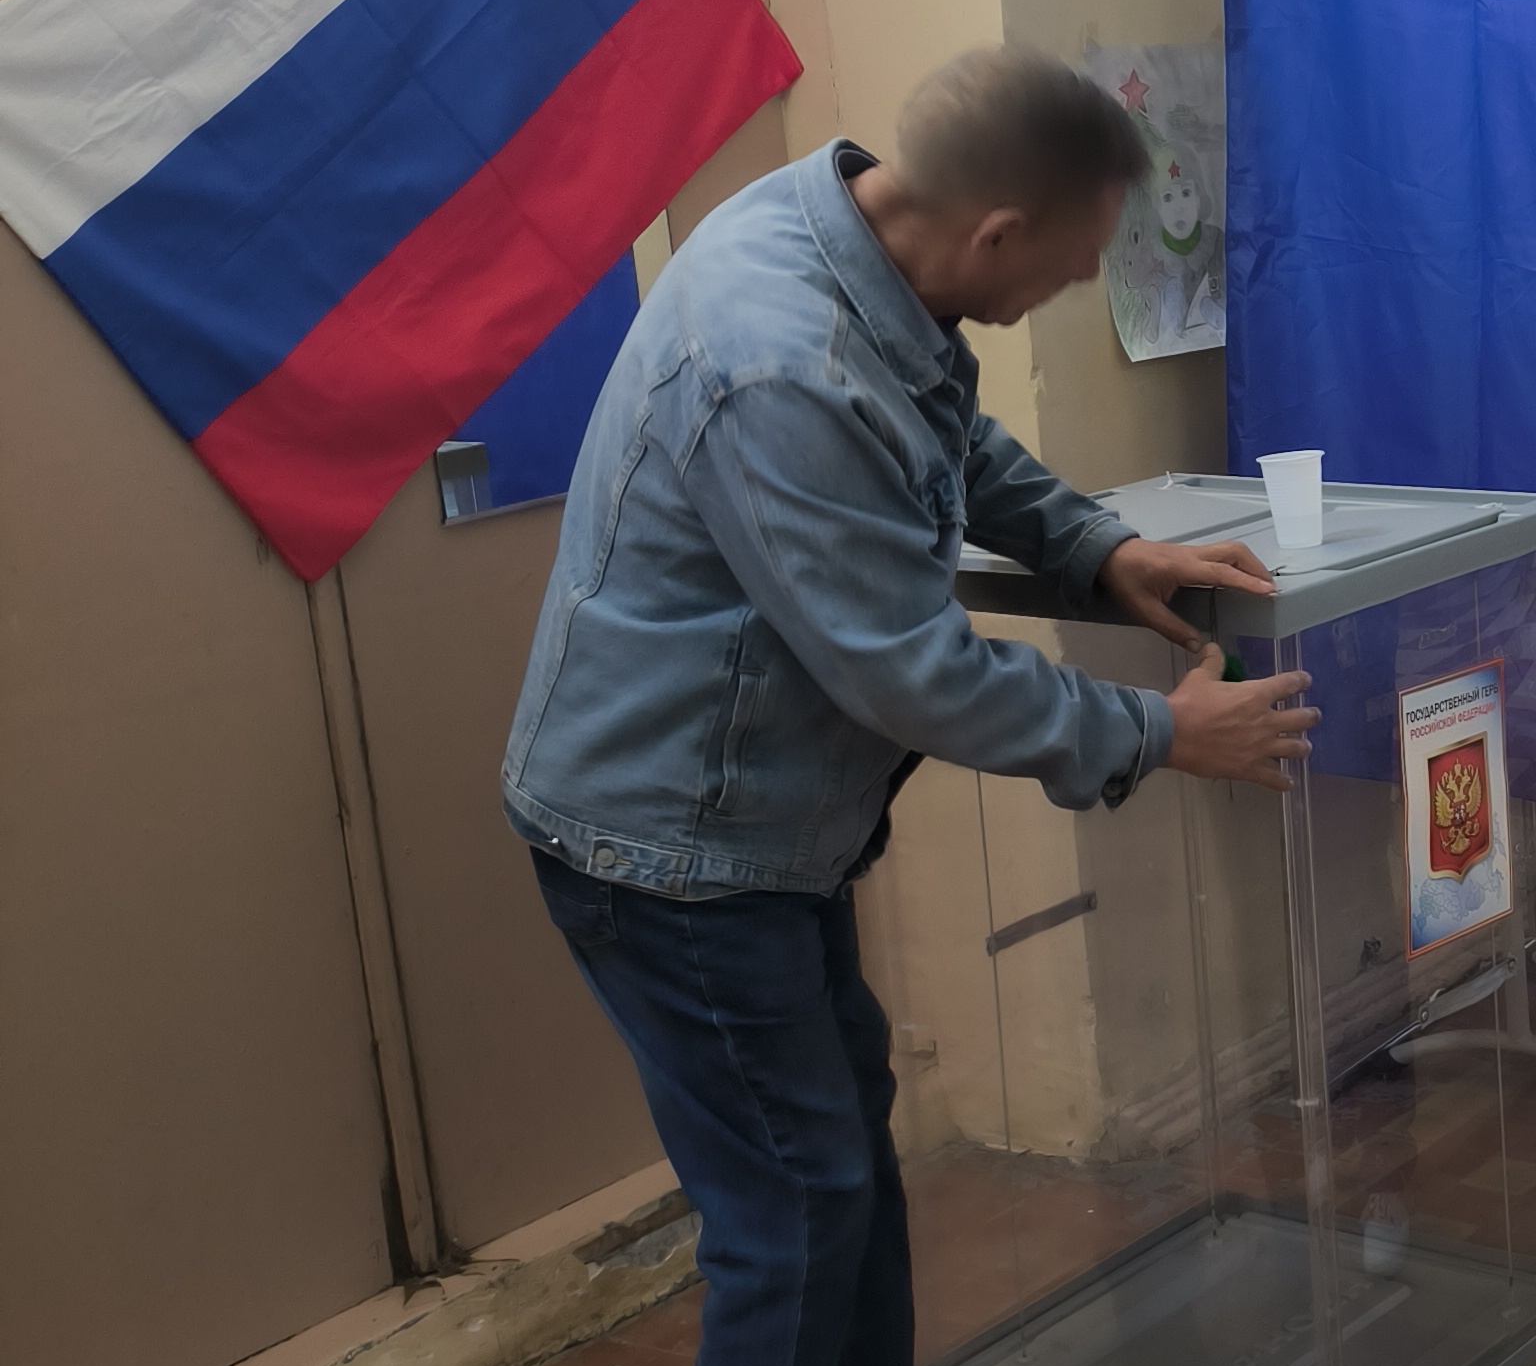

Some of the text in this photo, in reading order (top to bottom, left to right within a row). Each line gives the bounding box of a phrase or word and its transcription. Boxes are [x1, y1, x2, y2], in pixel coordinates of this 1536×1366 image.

[1406, 682, 1499, 725] ГОСУДАРСТВЕННЫЙ ГЕРБ
[1410, 701, 1497, 740] РОССИЙСКОЙ ФЕДЕРАЦИИ
